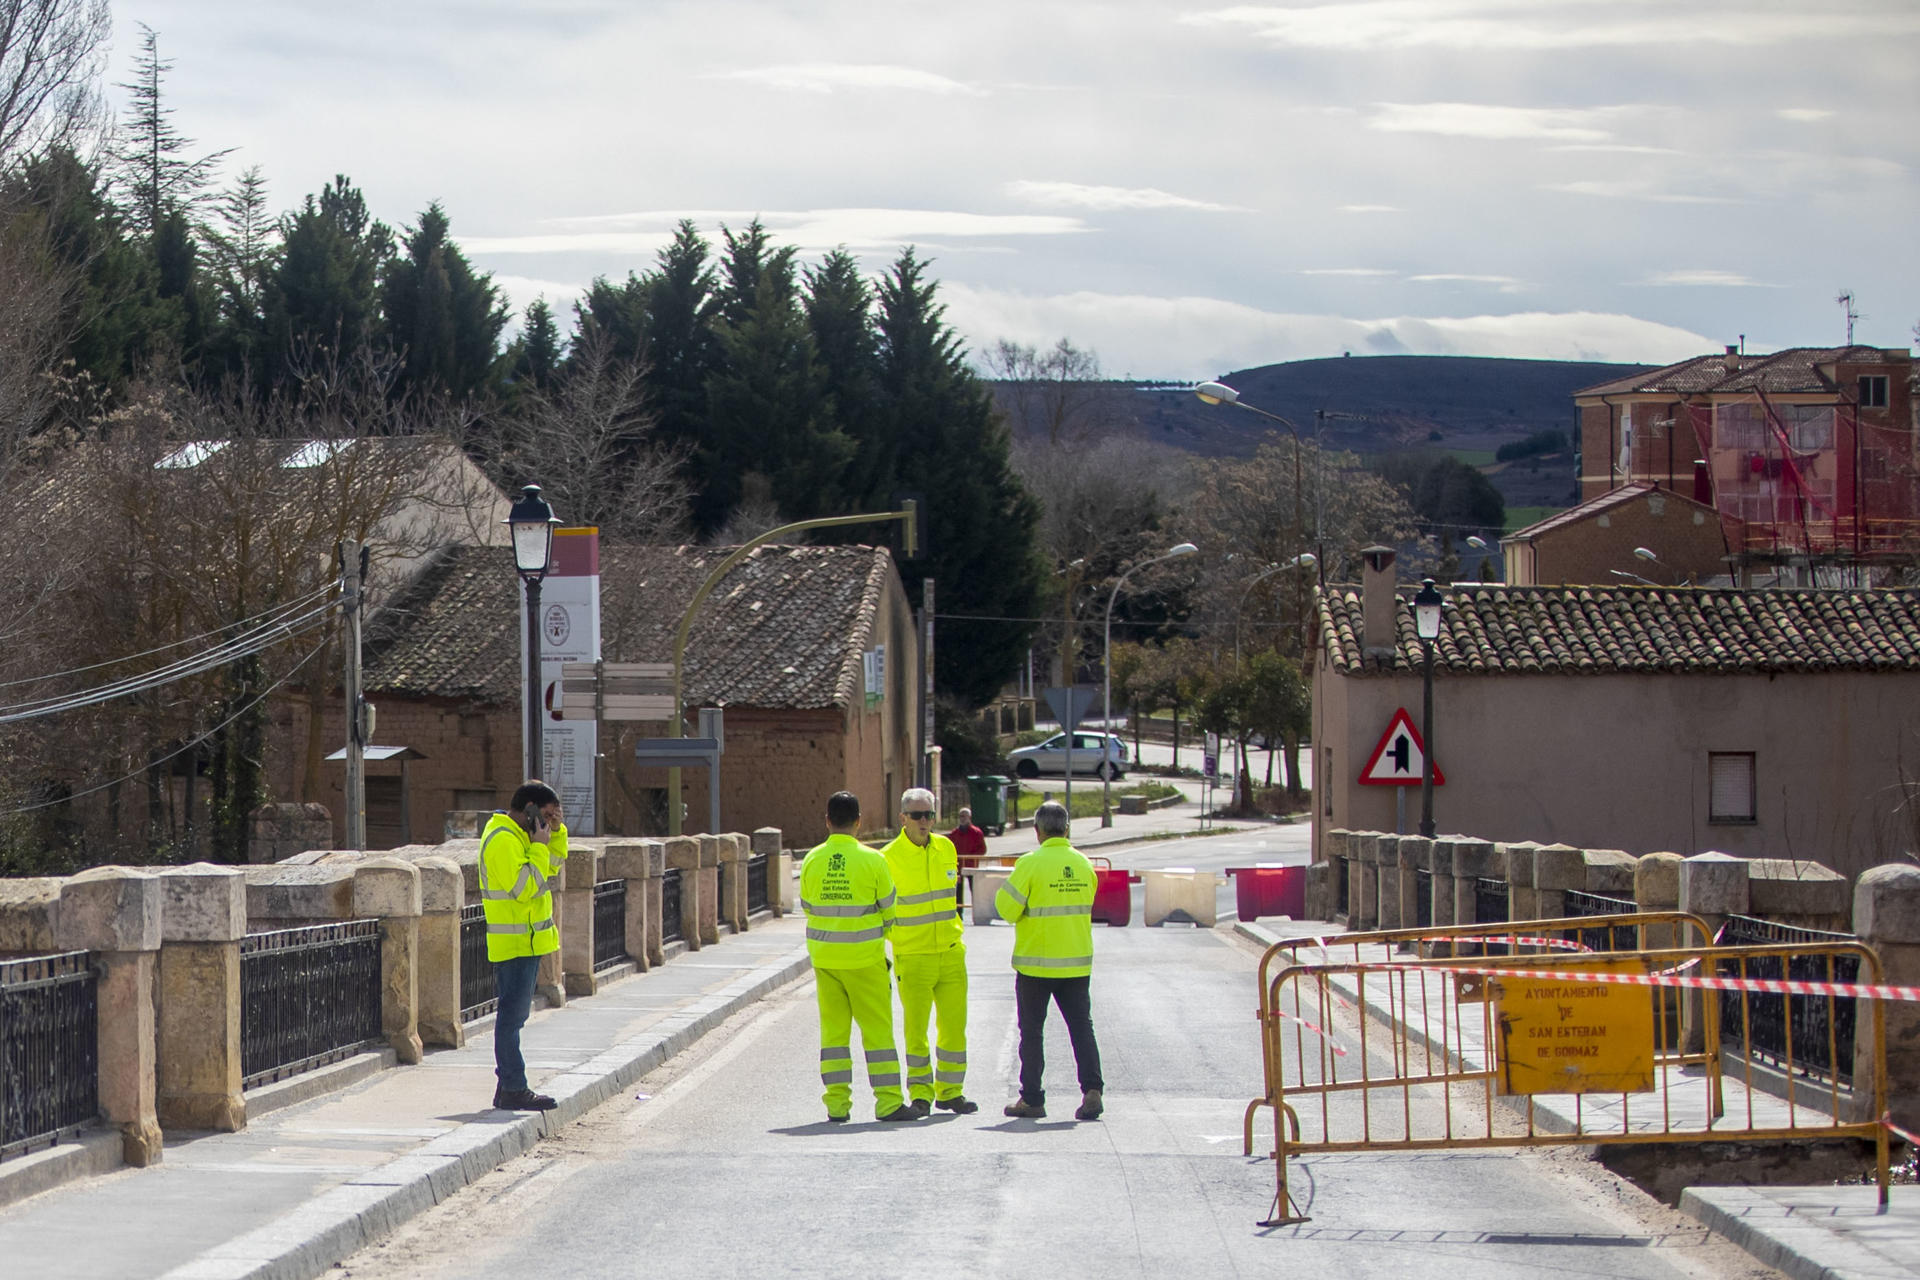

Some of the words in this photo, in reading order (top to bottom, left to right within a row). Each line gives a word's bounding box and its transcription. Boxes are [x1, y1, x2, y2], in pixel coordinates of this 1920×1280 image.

[1525, 985, 1608, 999] AYUNTAMIENTO
[1560, 1006, 1574, 1019] DE
[1528, 1027, 1553, 1038] SAN
[1557, 1026, 1607, 1038] ESTEBAN
[1537, 1047, 1551, 1058] DE
[1555, 1045, 1600, 1057] GORMAZ
